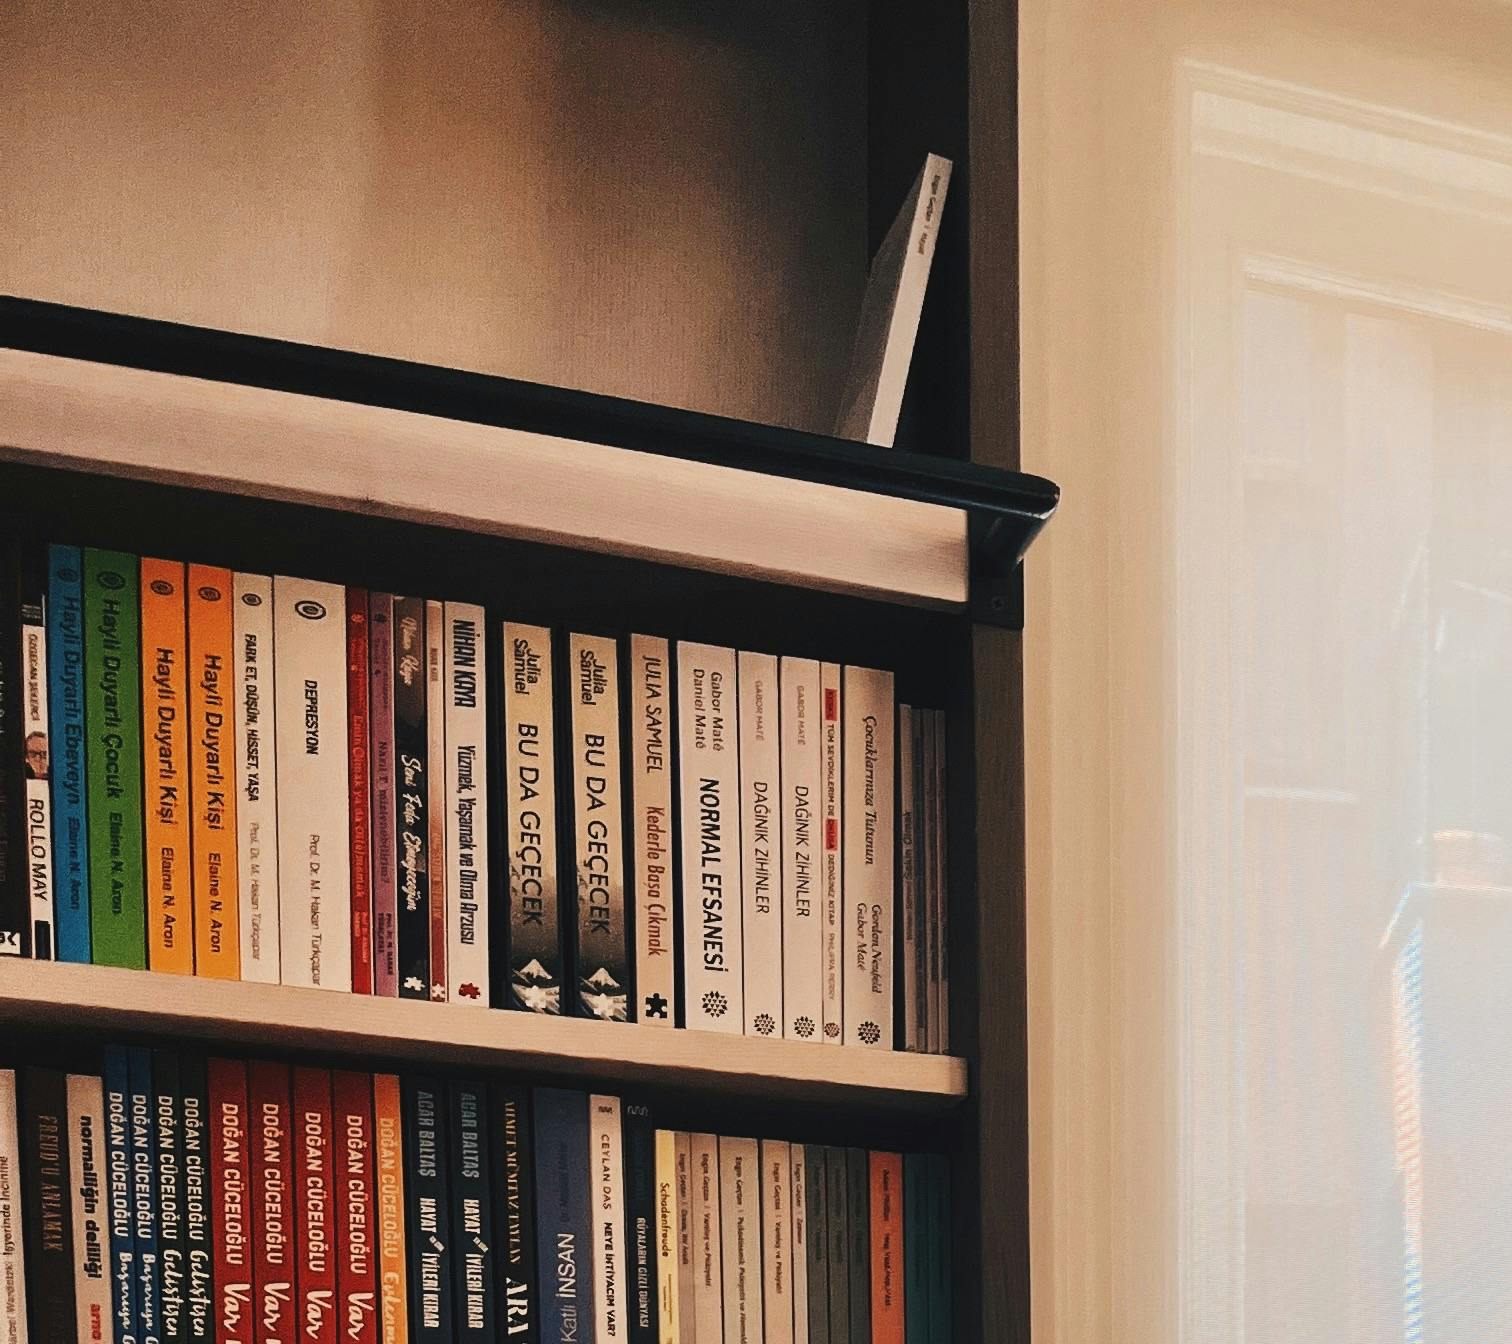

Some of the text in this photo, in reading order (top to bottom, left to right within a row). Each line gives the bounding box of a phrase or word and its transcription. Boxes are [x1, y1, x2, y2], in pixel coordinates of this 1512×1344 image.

[100, 655, 123, 728] Duyarlı
[452, 619, 481, 708] NİHAN KAYA
[512, 638, 529, 695] Samuel
[525, 648, 541, 684] Julia
[579, 649, 597, 705] Samuel
[592, 658, 609, 695] Julia
[242, 633, 262, 801] FARK ET, DÜŞÜN, HİSSET, YAŞA
[304, 679, 319, 755] DEPRESYON
[644, 656, 664, 774] JULIA SAMUEL
[691, 668, 708, 749] Daniel Maté
[709, 671, 726, 752] Gabor Maté
[102, 733, 125, 799] Çocuk
[152, 648, 178, 948] Hayli Duyarlı Kişi Elaine N. Aron
[200, 654, 225, 953] Hayli Duyarlı Kişi Elaine N. Aron
[28, 799, 48, 901] ROLLO MAY
[456, 744, 478, 945] Yüzmek, Yaşamak ve Olma Arzusu
[515, 722, 544, 926] BU DA GEÇECEK
[581, 733, 611, 934] BU DA GEÇECEK
[646, 806, 666, 859] Kederle
[752, 781, 773, 913] DAĞINIK ZİHİNLER
[794, 785, 813, 917] DAĞINIK ZİHİNLER
[864, 811, 879, 865] Tutunun
[698, 778, 729, 972] NORMAL EFSANESİ
[643, 903, 667, 956] Çıkmak
[78, 1115, 100, 1214] normalliğin
[132, 1094, 155, 1239] DOĞAN CÜCELOĞLU
[157, 1096, 180, 1239] DOĞAN CÜCELOĞLU
[183, 1098, 206, 1241] DOĞAN CÜCELOĞLU
[222, 1103, 248, 1265] DOĞAN CÜCELOĞLU
[263, 1103, 286, 1264] DOĞAN CÜCELOĞLU
[304, 1112, 330, 1272] DOĞAN CÜCELOĞLU
[346, 1115, 371, 1274] DOĞAN CÜCELOĞLU
[600, 1134, 614, 1210] CEYLAN DAŞ
[83, 1220, 102, 1279] deliliği
[419, 1197, 437, 1233] HAYAT
[463, 1199, 481, 1234] HAYAT
[659, 1182, 673, 1257] Schadenfreude
[555, 1233, 577, 1298] İNSAN
[603, 1222, 617, 1337] NEYE İHTİYACIM VAR?
[89, 1304, 102, 1341] arno
[222, 1282, 251, 1332] Var
[263, 1282, 291, 1331] Var
[304, 1290, 333, 1339] Var
[346, 1292, 374, 1342] Var
[423, 1294, 440, 1328] KIRAR
[467, 1294, 484, 1329] KIRAR
[504, 1276, 529, 1336] ARA
[560, 1304, 579, 1344] Katlı
